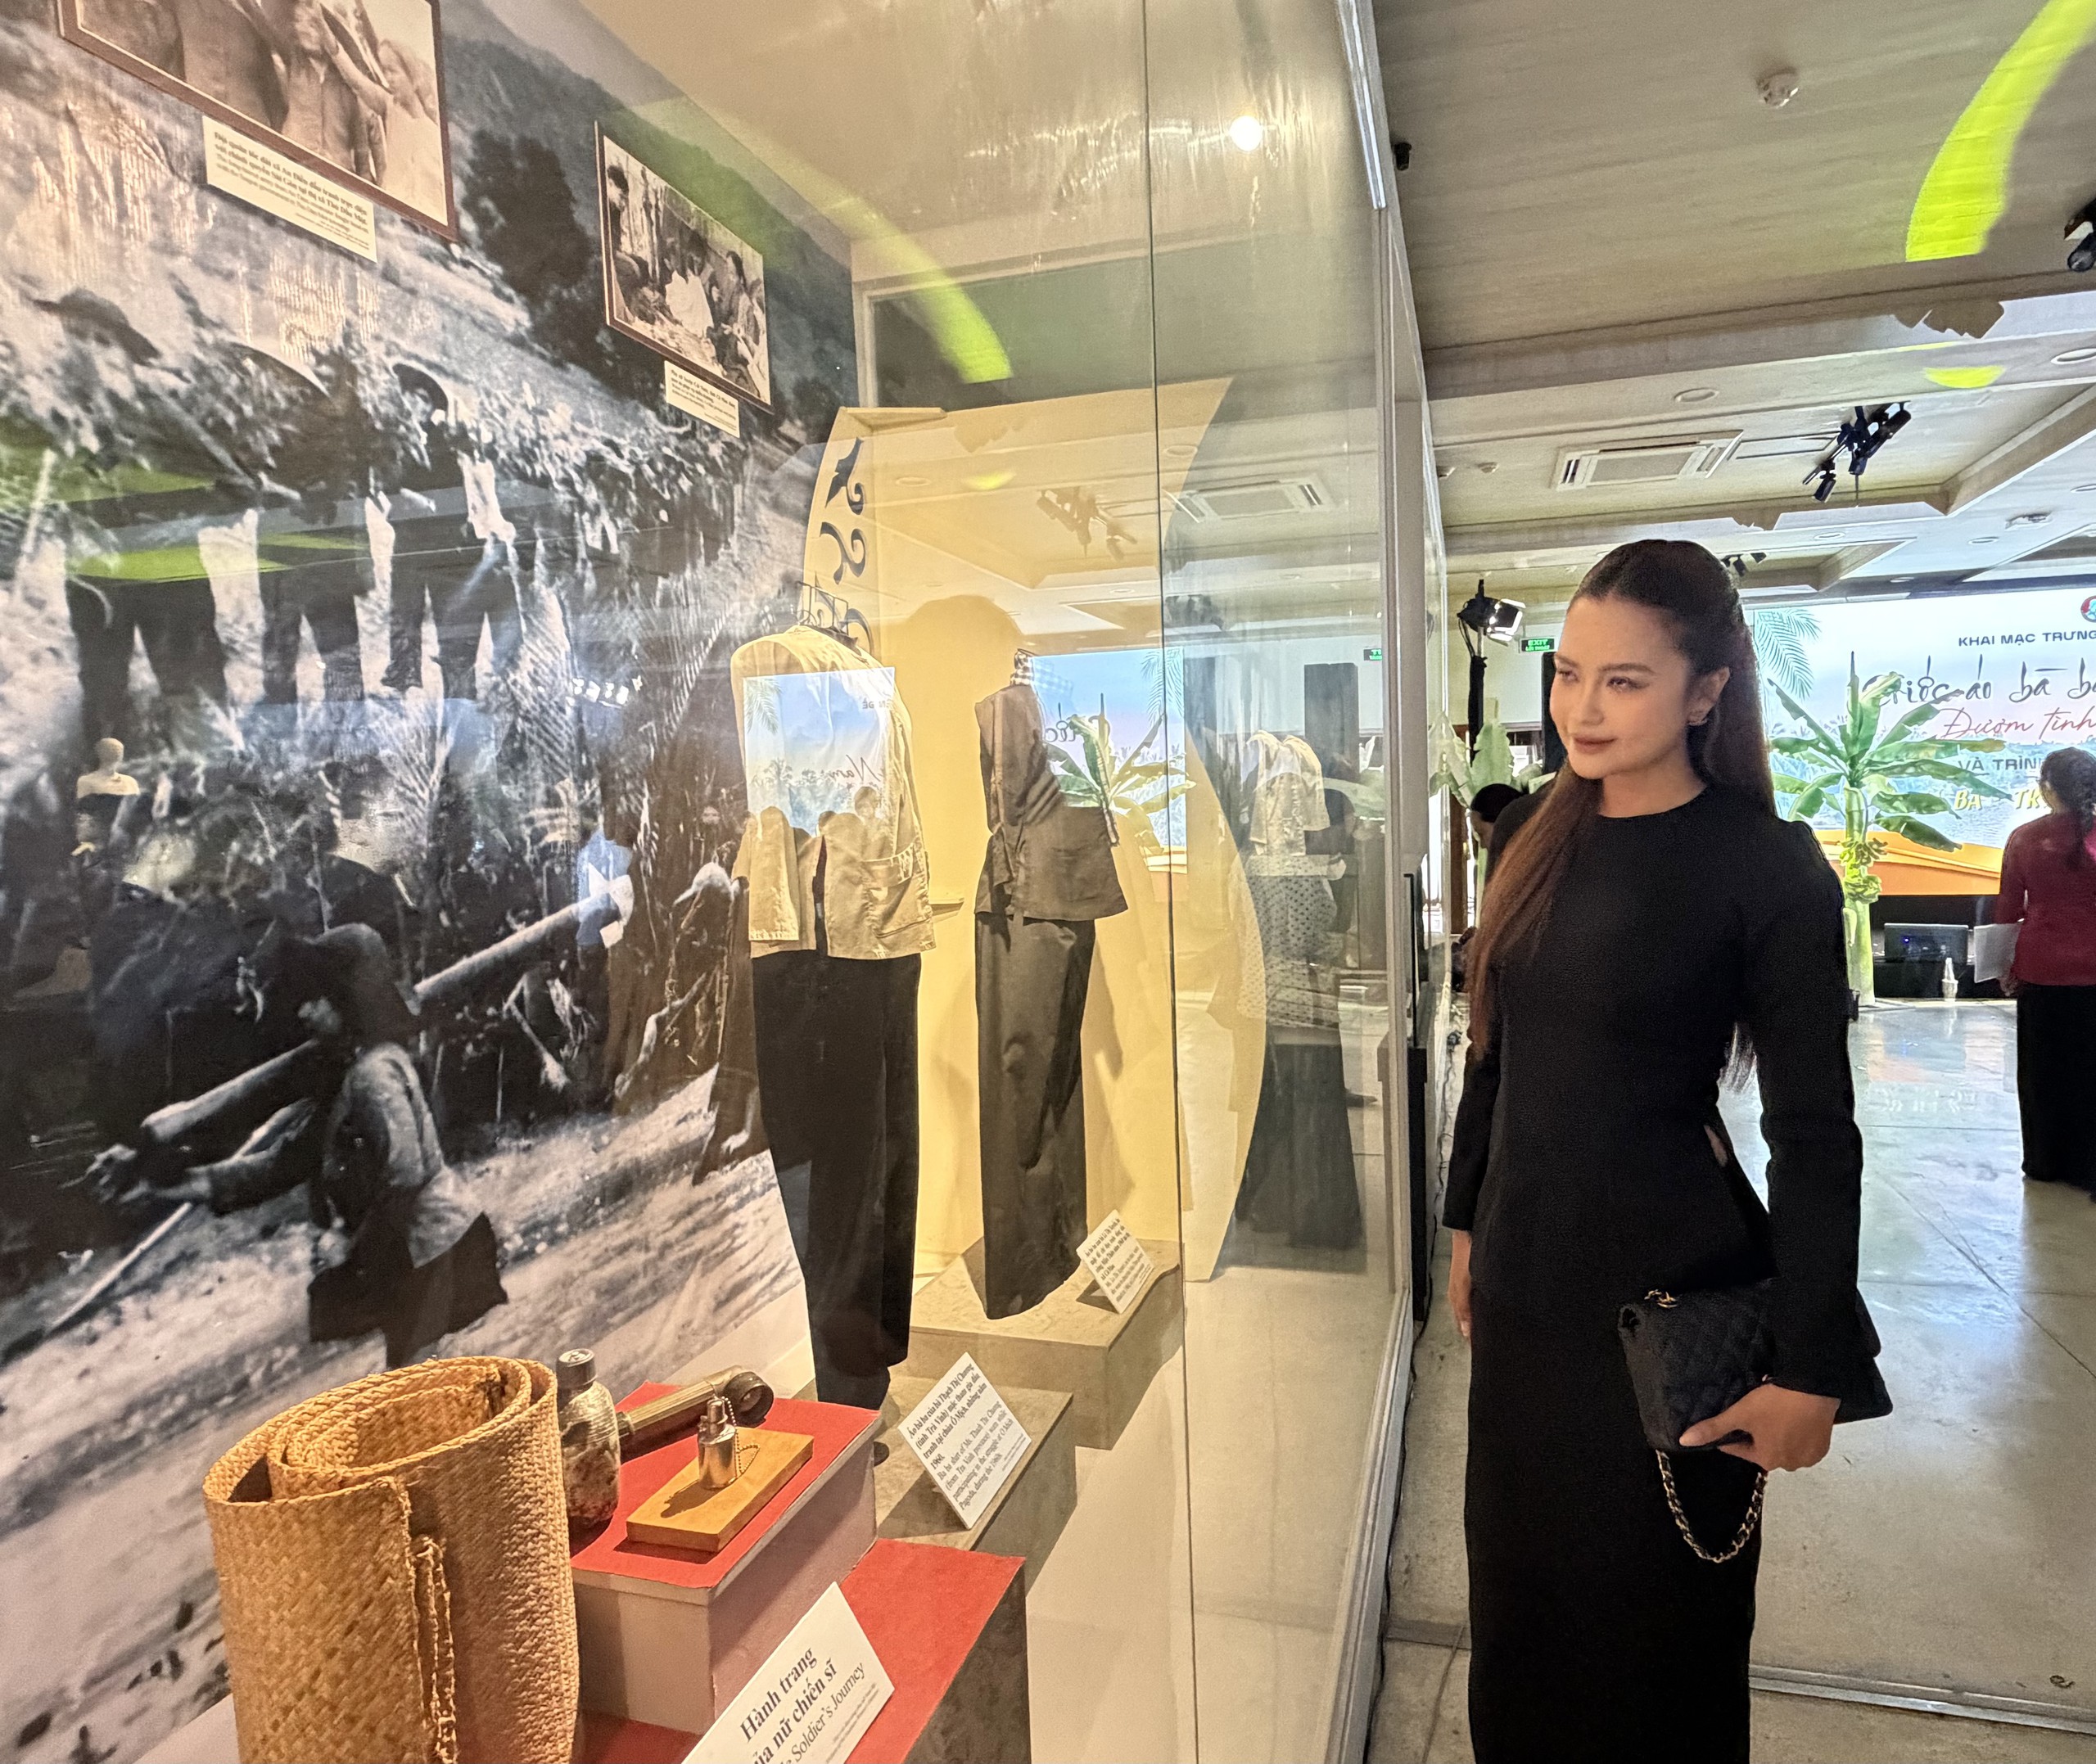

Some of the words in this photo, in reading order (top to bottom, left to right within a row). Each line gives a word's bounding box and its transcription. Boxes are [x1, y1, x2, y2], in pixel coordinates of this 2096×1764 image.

[1958, 635, 1994, 647] KHAI
[2001, 634, 2036, 646] MẠC
[2042, 629, 2096, 643] TRƯNG
[1992, 755, 2041, 771] TRÌN
[740, 1690, 782, 1743] Hành
[779, 1647, 818, 1692] trang
[772, 1717, 793, 1750] nữ
[793, 1676, 826, 1723] chiến
[824, 1657, 838, 1682] sĩ
[830, 1662, 865, 1710] Journey
